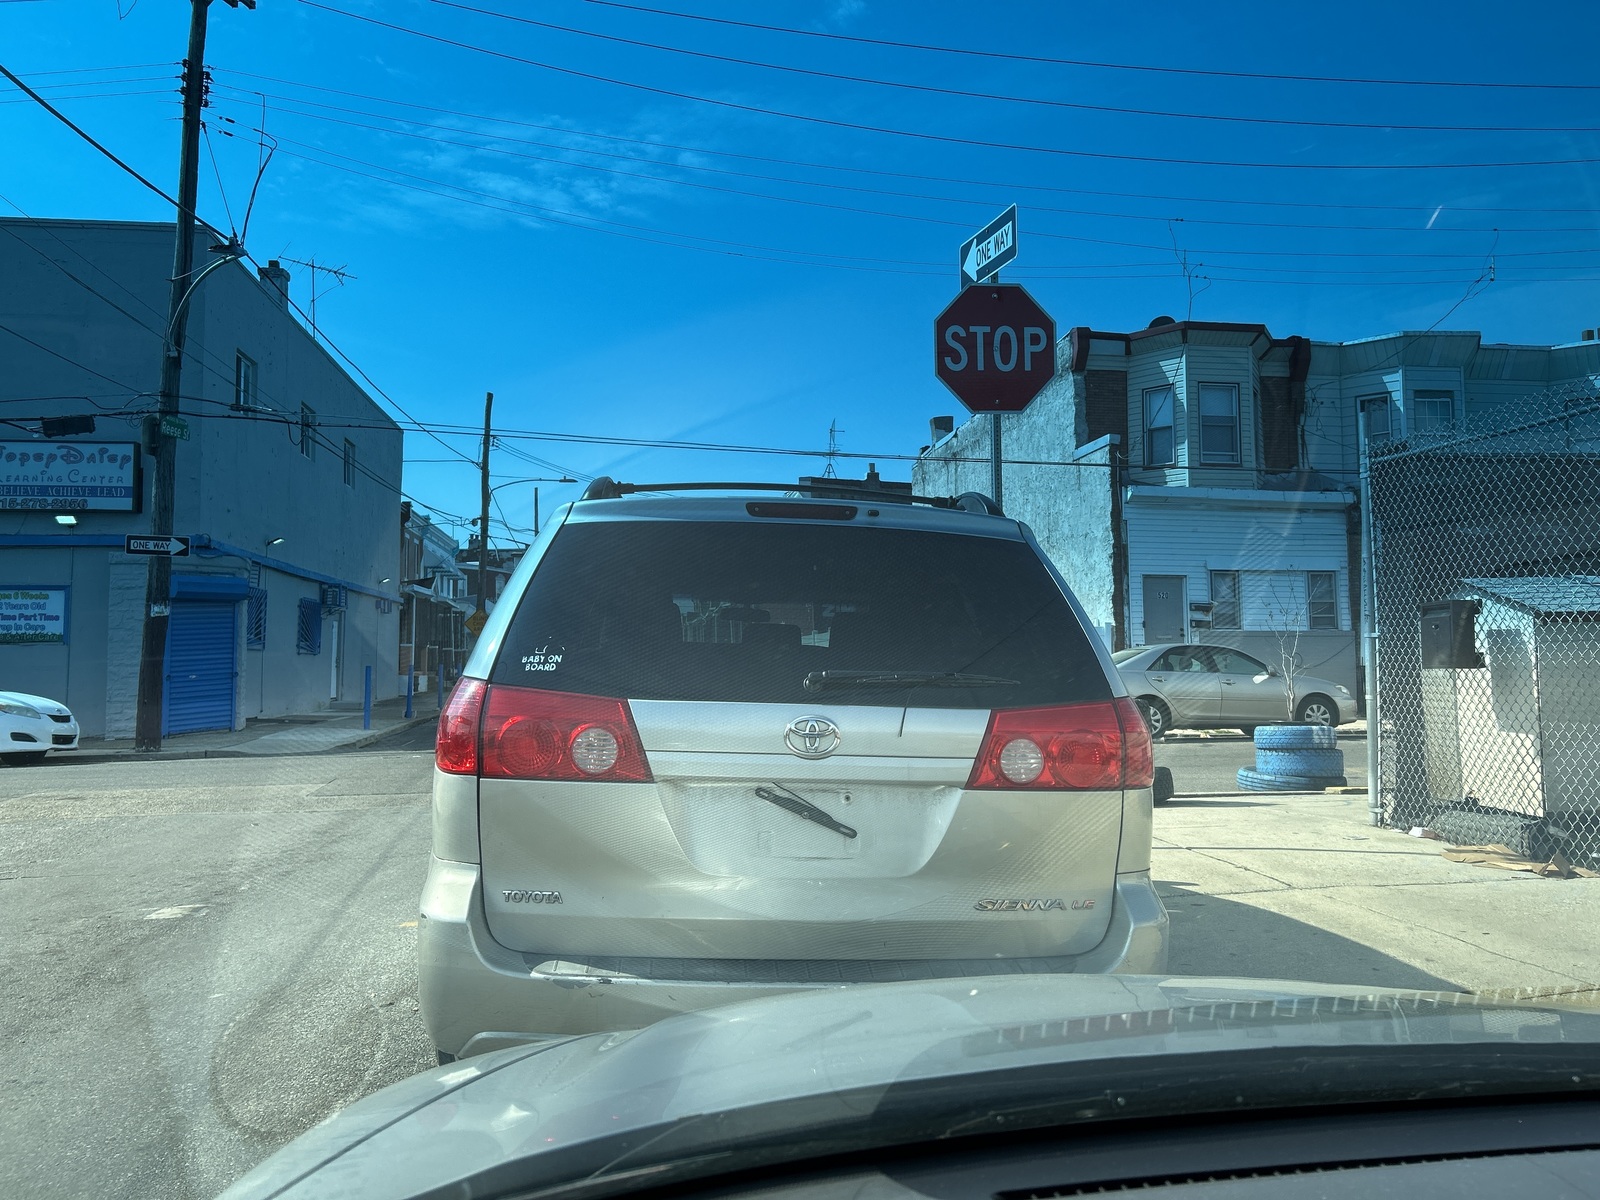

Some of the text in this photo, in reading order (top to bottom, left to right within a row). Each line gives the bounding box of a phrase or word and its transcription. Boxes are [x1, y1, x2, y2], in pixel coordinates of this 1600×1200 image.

[975, 226, 1012, 268] ONE WAY
[944, 324, 1048, 373] STOP
[161, 421, 190, 441] Reese St
[0, 469, 63, 483] EARNING
[45, 486, 92, 497] ACHIEVE
[97, 487, 125, 497] LEAD
[132, 540, 171, 550] ONE WAY
[13, 591, 20, 600] 6
[20, 591, 49, 600] Weeks
[1157, 591, 1170, 600] 520
[4, 601, 29, 610] Years
[30, 601, 47, 610] Old
[18, 612, 38, 621] Part
[38, 613, 60, 622] Time
[14, 622, 23, 631] In
[24, 622, 46, 631] Care
[14, 633, 38, 641] After
[38, 633, 60, 641] Care
[521, 654, 563, 663] BABY ON
[525, 663, 557, 672] BOARD
[502, 889, 564, 905] TOYOTA
[973, 898, 1096, 911] SIENNA LE
